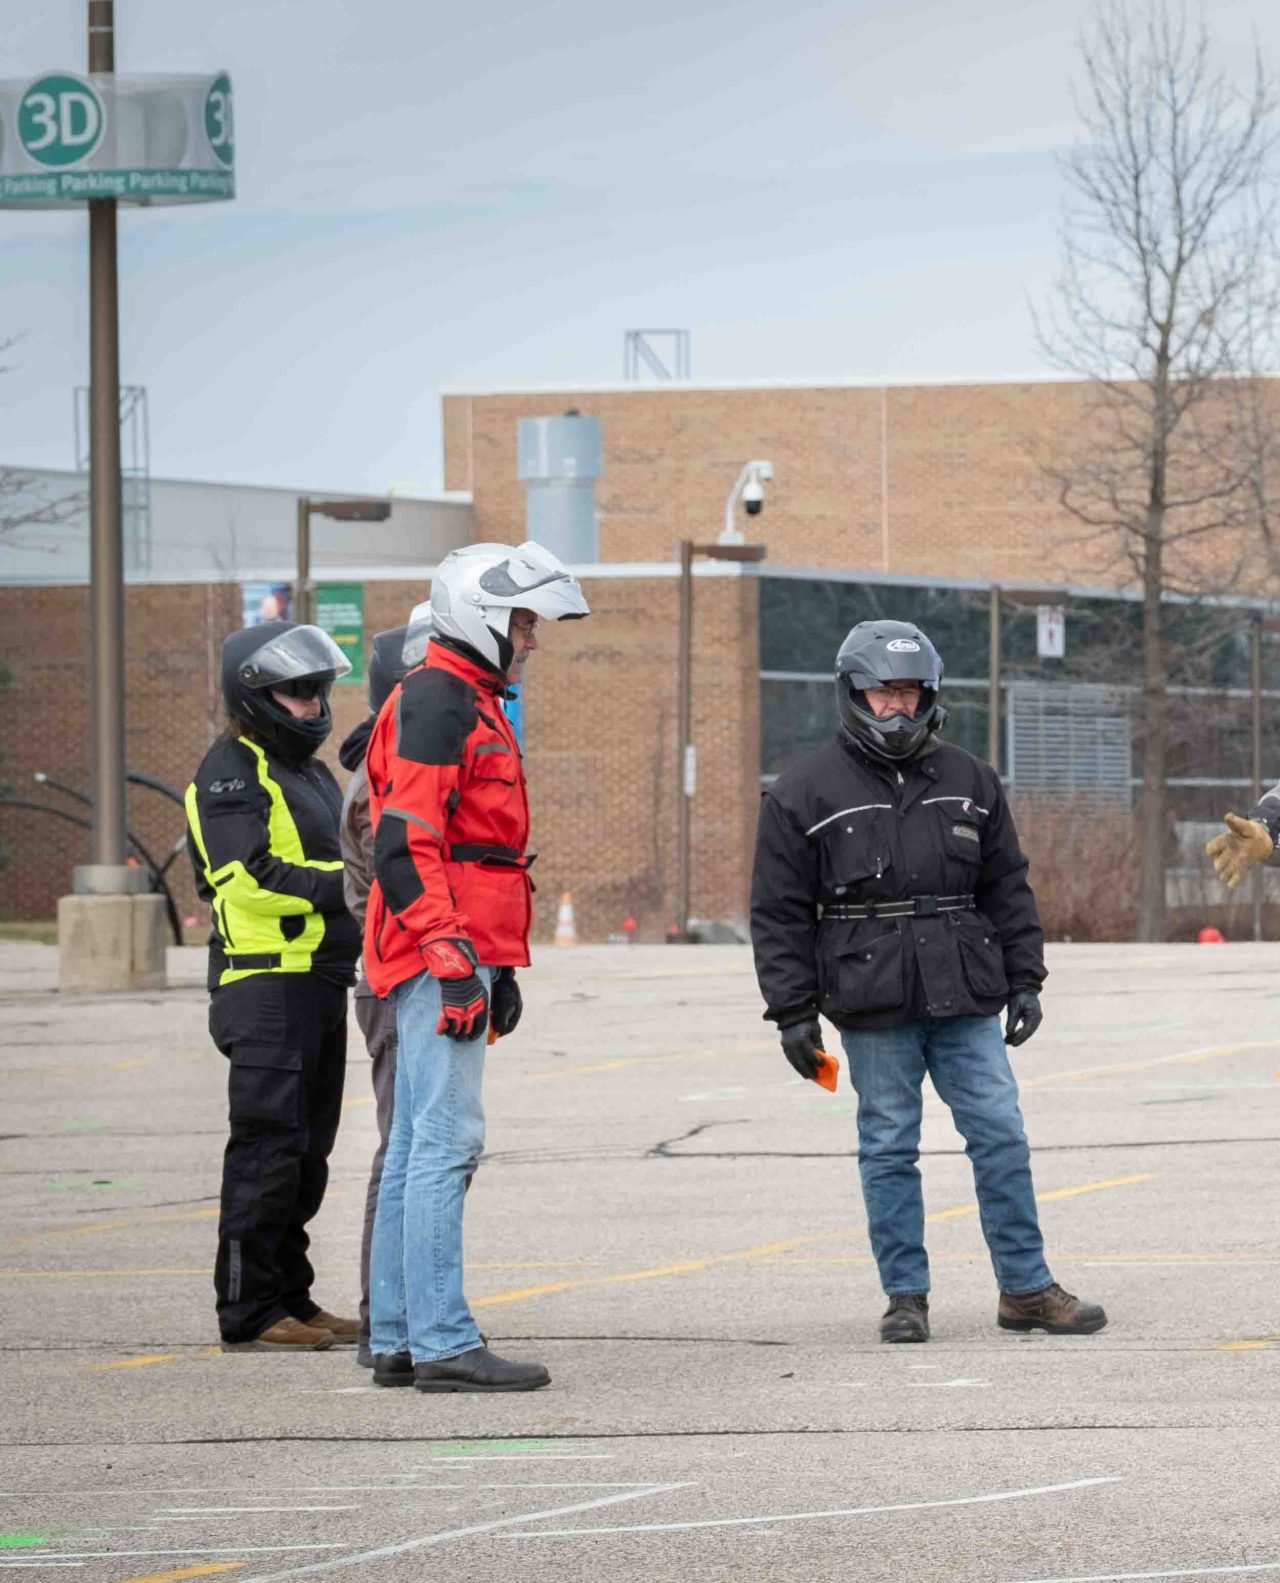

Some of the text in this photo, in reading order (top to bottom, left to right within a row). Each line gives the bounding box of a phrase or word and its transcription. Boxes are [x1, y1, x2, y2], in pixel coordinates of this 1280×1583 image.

[24, 91, 99, 151] 3D
[61, 173, 125, 193] Parking
[129, 171, 188, 192] Parking
